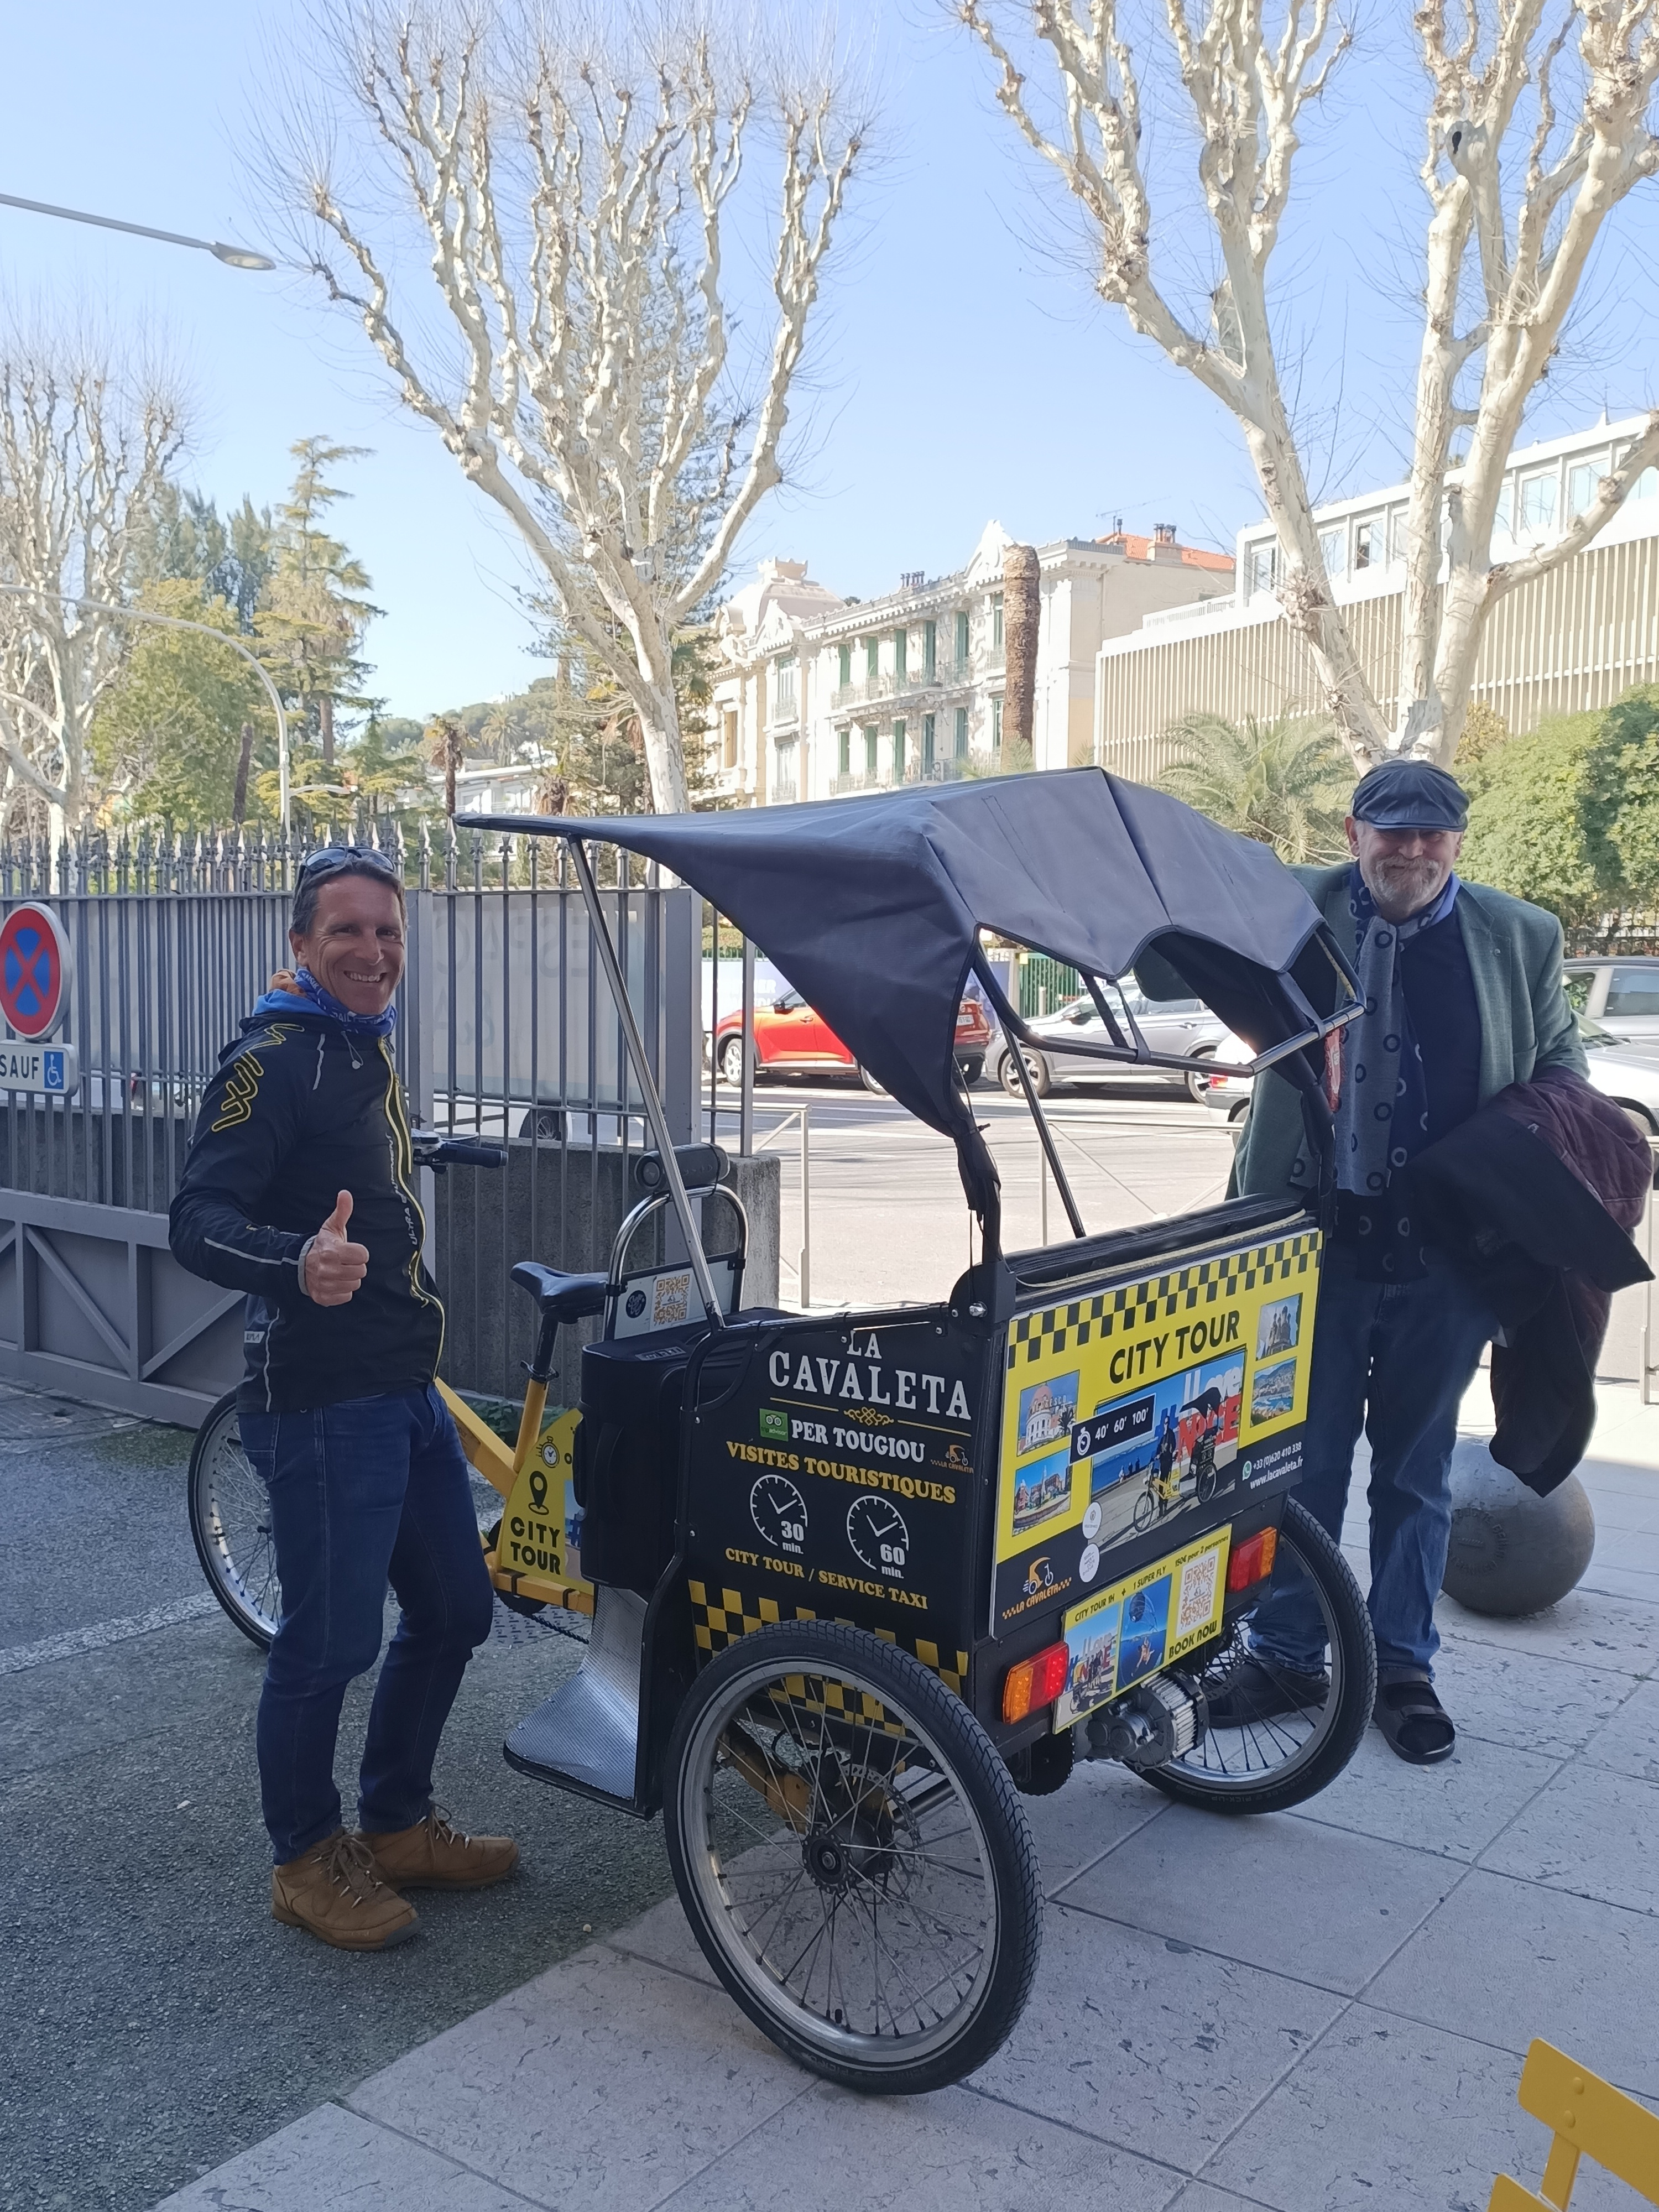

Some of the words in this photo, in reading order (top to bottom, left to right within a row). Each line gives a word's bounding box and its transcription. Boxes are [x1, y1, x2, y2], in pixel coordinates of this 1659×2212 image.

[0, 1054, 39, 1079] SAUF
[404, 1207, 418, 1245] ULTRA
[847, 1330, 882, 1359] LA
[1109, 1333, 1171, 1384] CITY
[1175, 1310, 1240, 1361] TOUR
[769, 1350, 972, 1421] CAVALETA
[761, 1426, 787, 1437] tripadvisor
[1114, 1416, 1127, 1433] 60'
[1133, 1407, 1149, 1426] 100'
[791, 1419, 828, 1445] PER
[833, 1427, 925, 1463] TOUGIOU
[726, 1441, 799, 1471] VISITES
[804, 1457, 956, 1504] TOURISTIQUES
[948, 1462, 974, 1474] CAVALETA
[1250, 1455, 1303, 1490] www.lacavaleta.fr
[1253, 1458, 1263, 1470] +33
[1263, 1450, 1281, 1469] (0)620
[1281, 1445, 1291, 1458] 410
[510, 1516, 561, 1548] CITY
[780, 1520, 805, 1542] 30
[510, 1541, 561, 1575] TOUR
[782, 1541, 804, 1554] min.
[880, 1543, 905, 1566] 60
[725, 1547, 758, 1567] CITY
[763, 1555, 805, 1579] TOUR
[808, 1568, 815, 1582] /
[818, 1570, 886, 1598] SERVICE
[888, 1587, 928, 1610] TAXI
[881, 1566, 905, 1579] min.
[1074, 1608, 1089, 1622] CITY
[1090, 1598, 1107, 1615] TOUR
[1108, 1593, 1115, 1604] 1H
[1137, 1572, 1155, 1588] SUPER
[1156, 1564, 1167, 1578] FLY
[1187, 1550, 1199, 1563] pour
[1200, 1545, 1204, 1554] 2
[1204, 1535, 1229, 1553] personnes
[1016, 1600, 1024, 1613] LA
[1026, 1584, 1059, 1610] CAVALETA
[1169, 1632, 1195, 1660] BOOK
[1197, 1620, 1218, 1646] NOW
